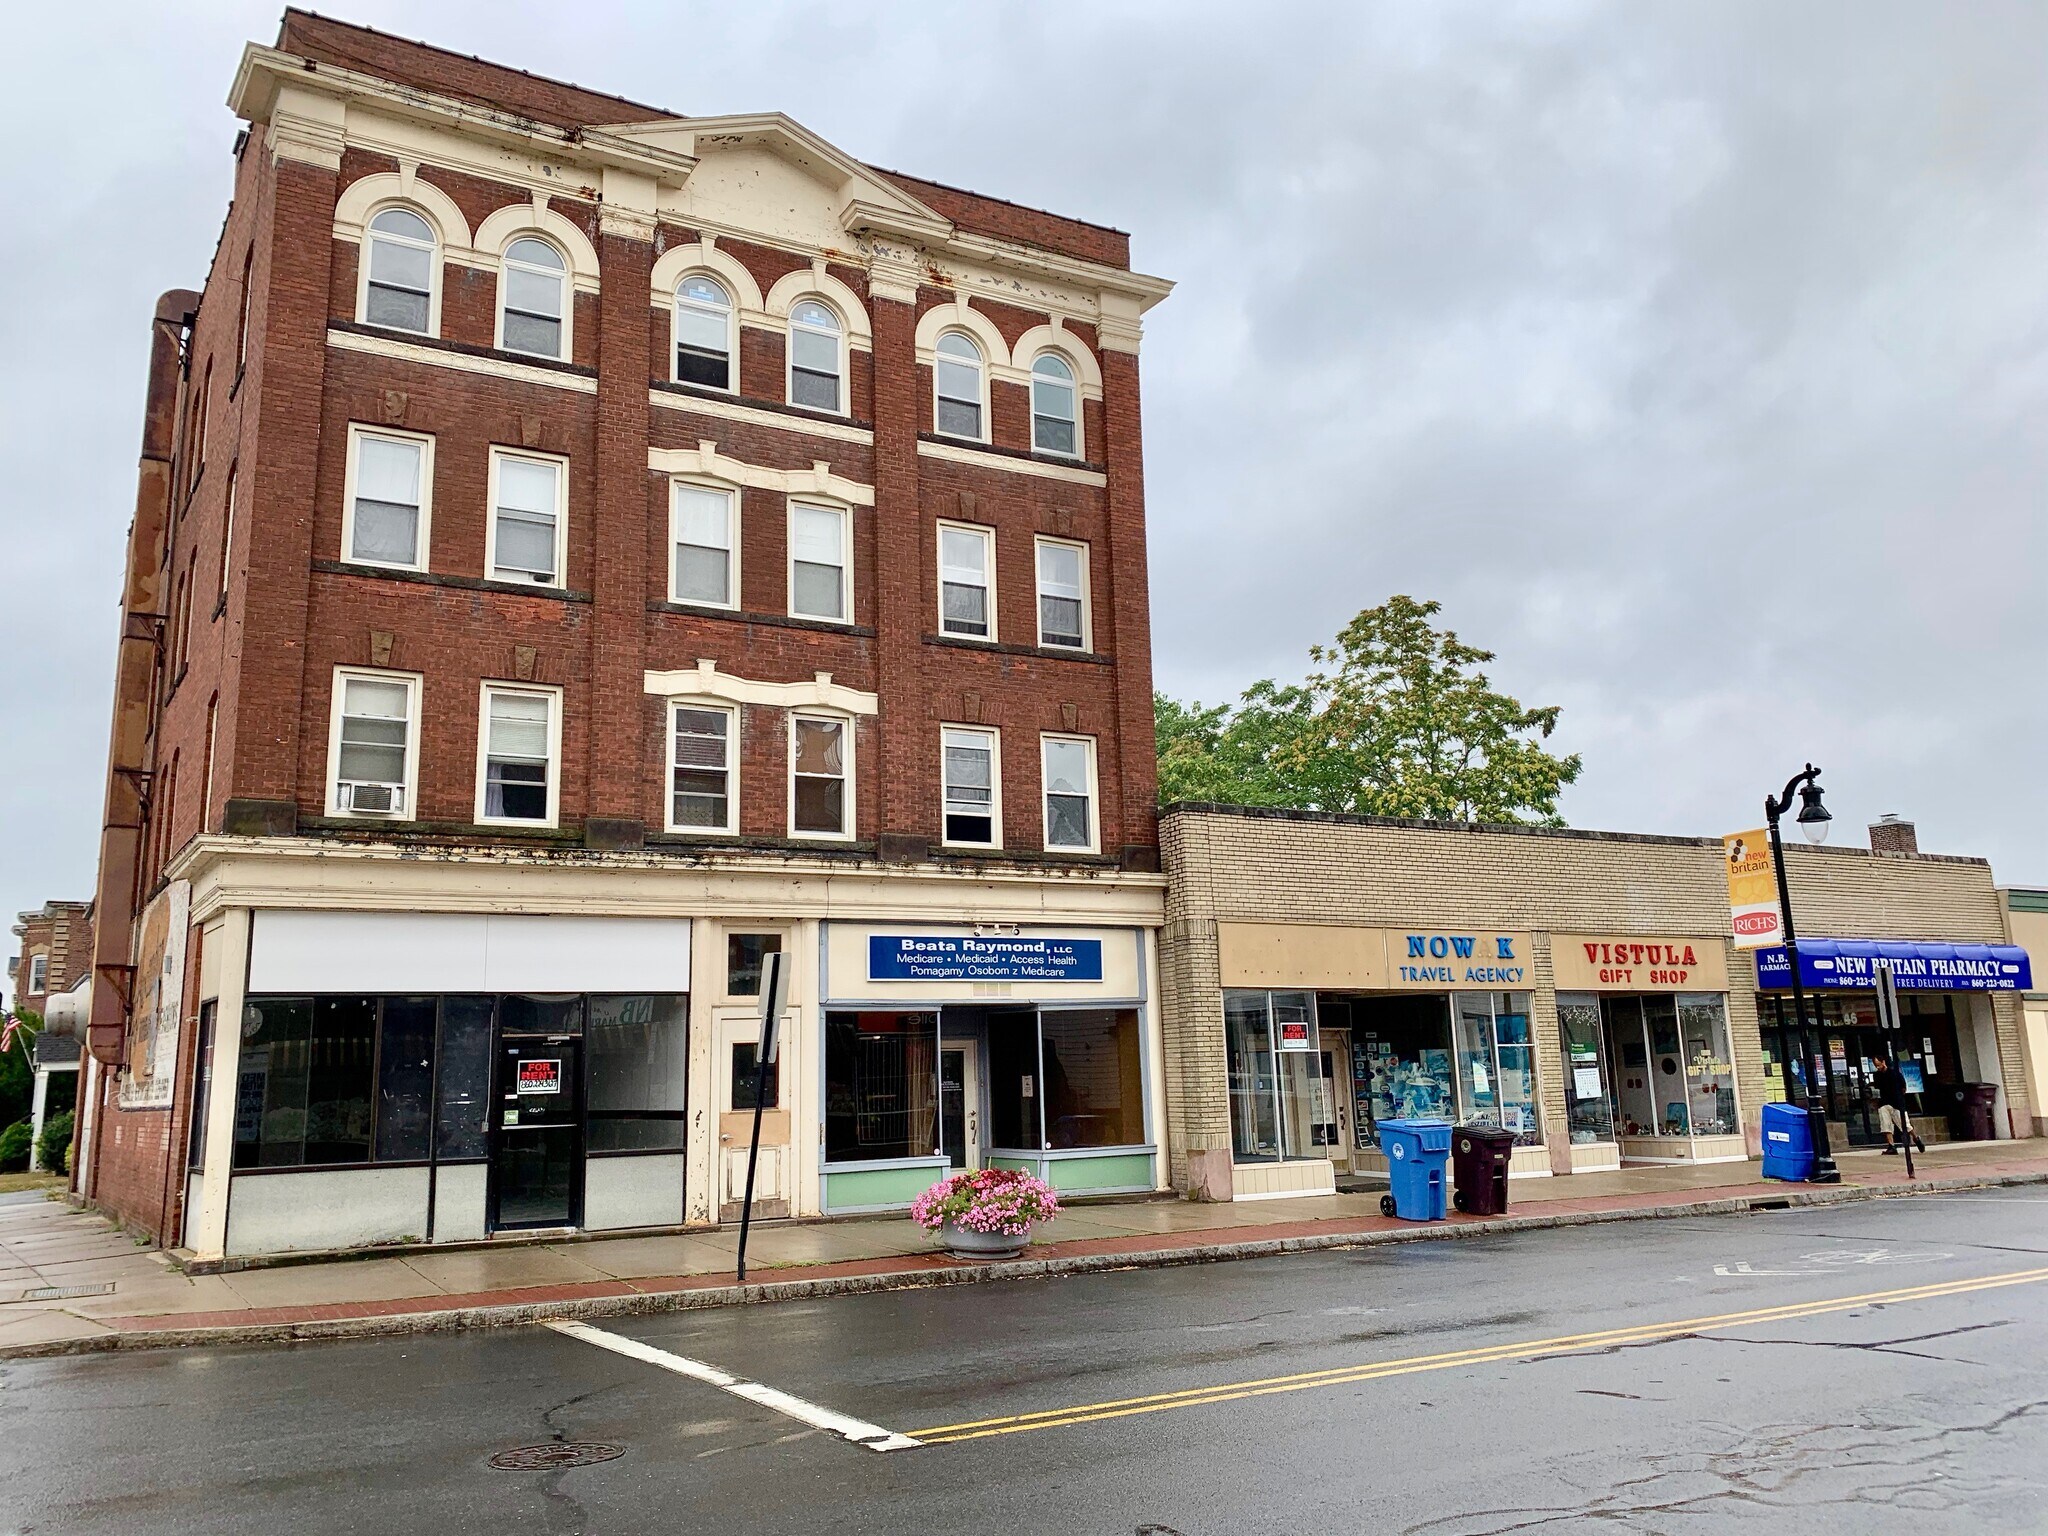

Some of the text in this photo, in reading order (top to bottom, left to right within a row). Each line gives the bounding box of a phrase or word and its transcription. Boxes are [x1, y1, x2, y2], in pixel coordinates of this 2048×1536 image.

[1745, 850, 1767, 861] new
[1731, 860, 1769, 874] britain
[1735, 916, 1776, 932] RICH'S
[901, 939, 1073, 955] Beata Raymond, LLC
[896, 953, 1077, 966] Medicare Medicaid Access Health
[1583, 943, 1698, 966] VISTULA
[1766, 953, 1788, 964] N.B.
[910, 965, 1065, 977] Pomagamy Osobom z Medicare
[1835, 956, 2000, 977] NEW BRITAIN PHARMACY
[1399, 966, 1524, 983] TRAVEL AGENCY
[1599, 968, 1688, 984] GIFT SHOP
[1896, 978, 1954, 988] FREE DELIVERY
[528, 1063, 550, 1071] FOR
[1687, 1064, 1731, 1077] GIFT SHOP
[521, 1071, 556, 1080] RENT
